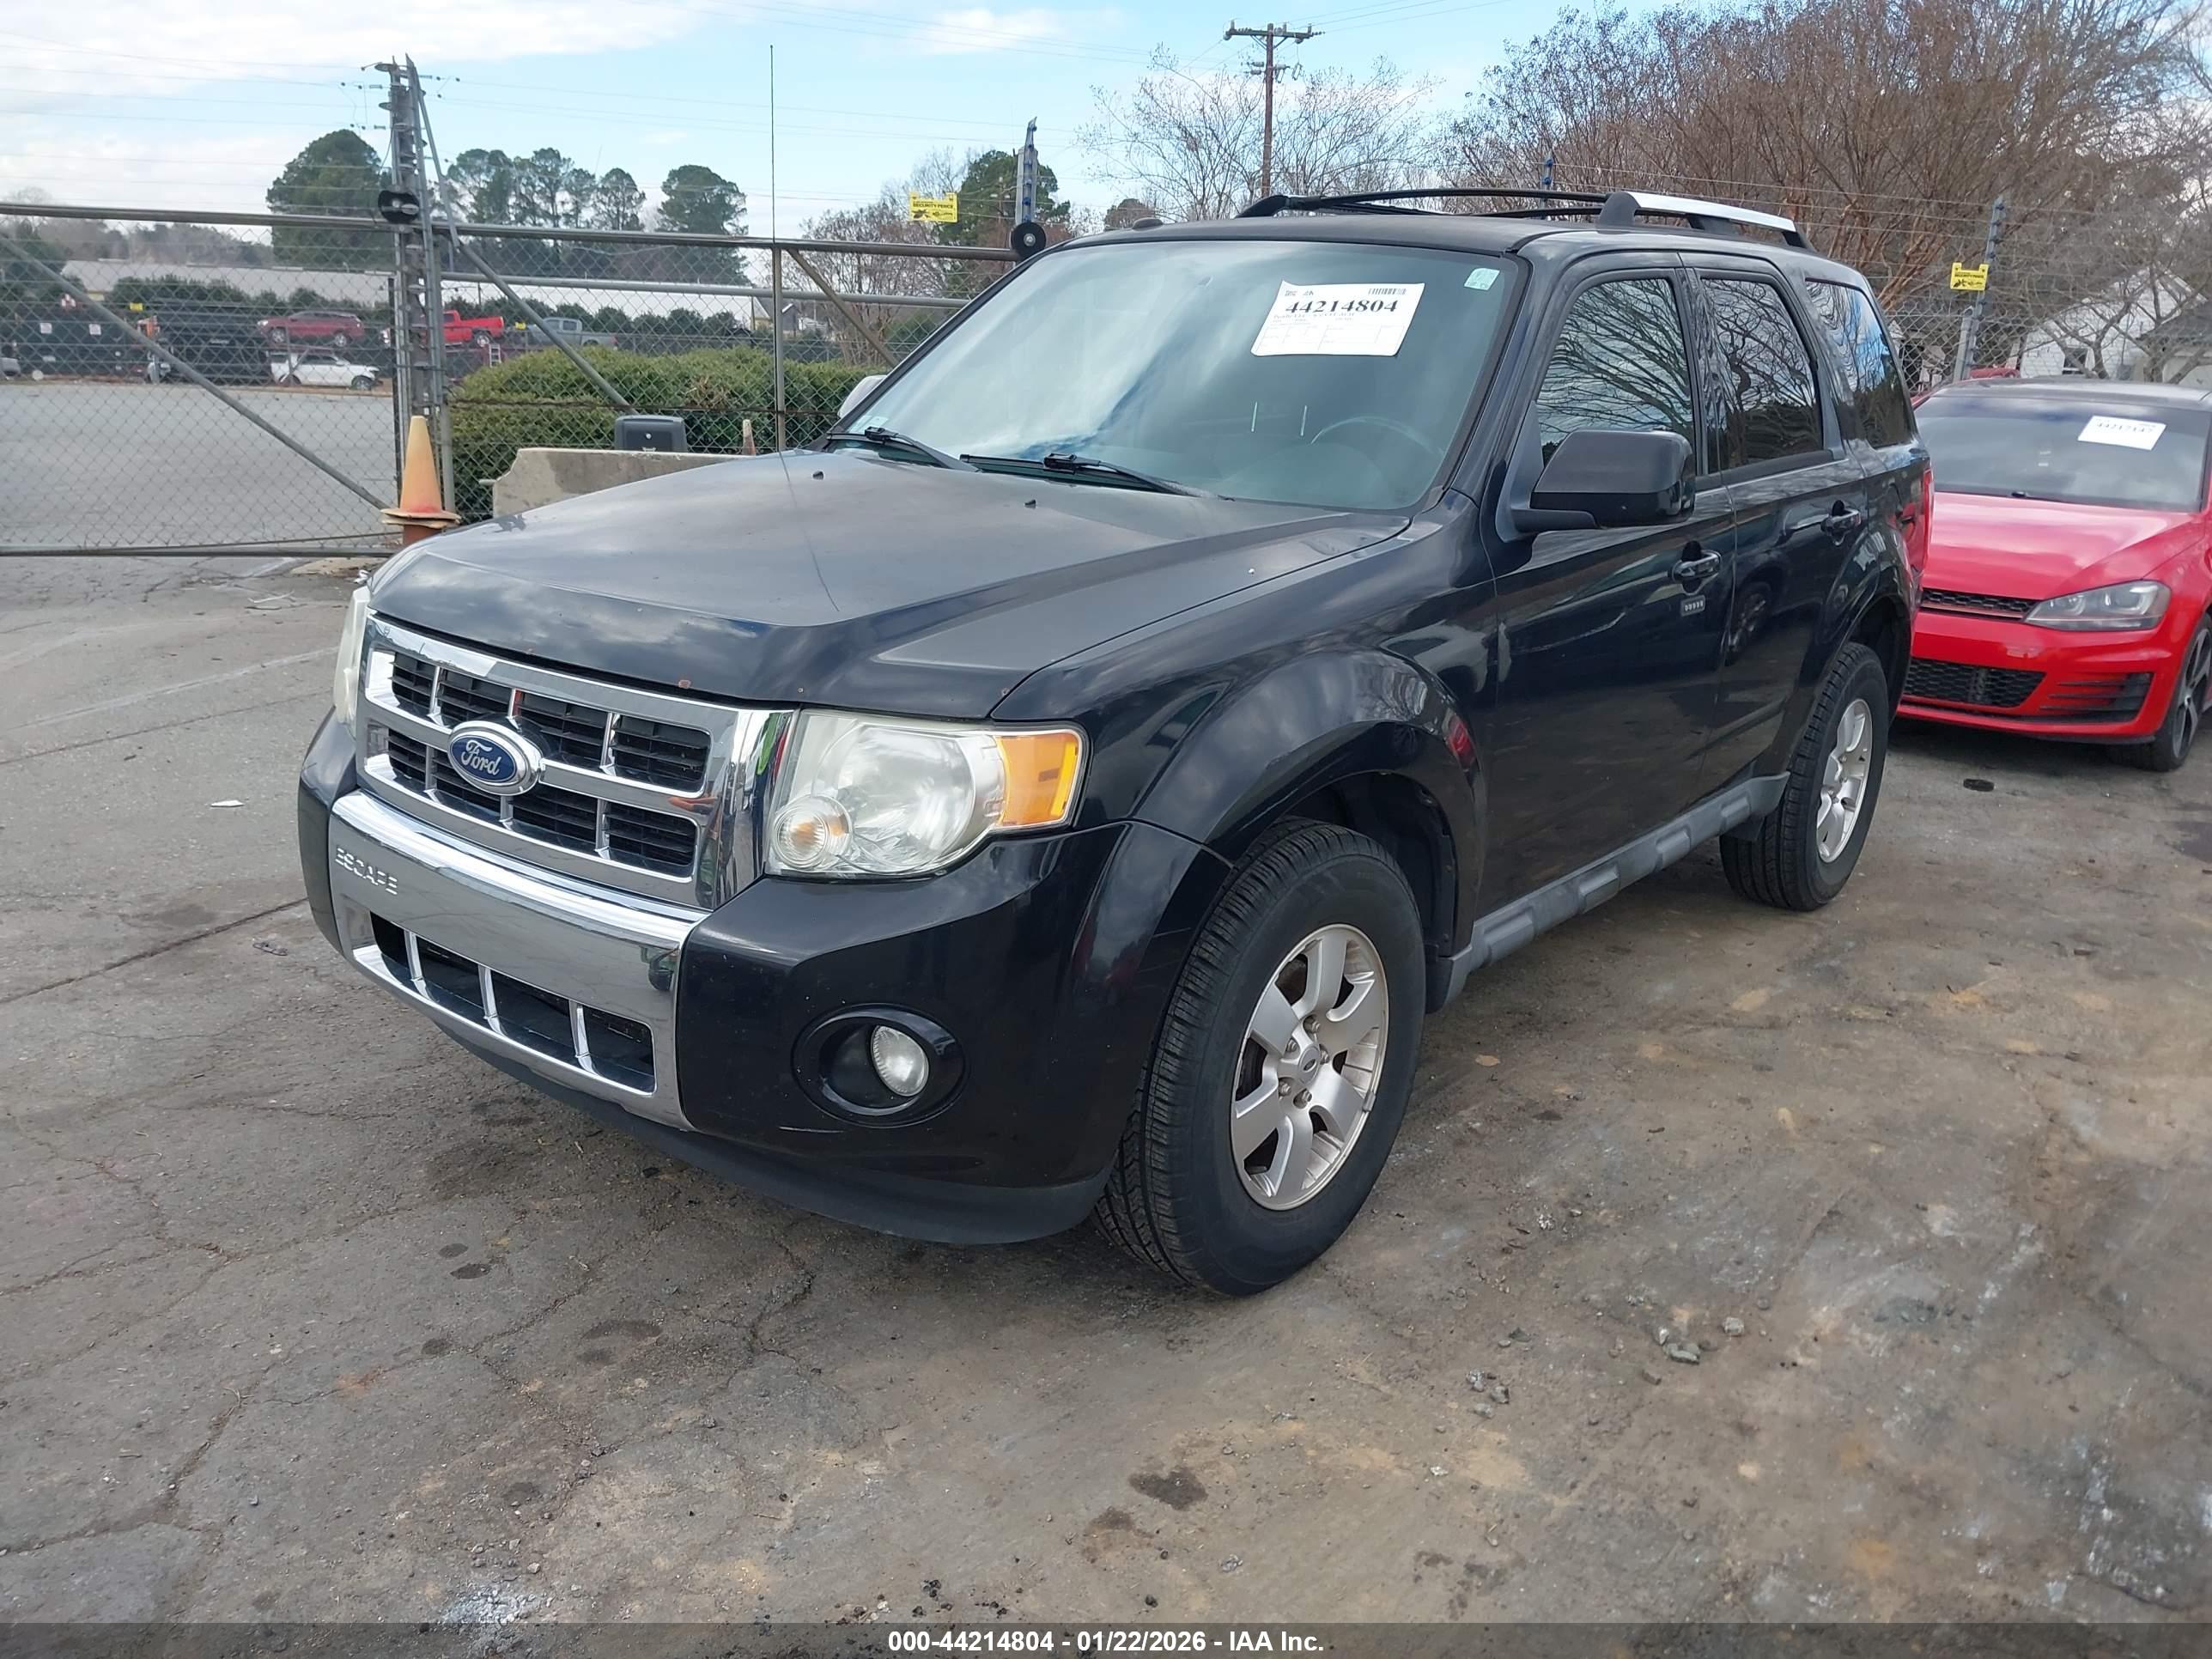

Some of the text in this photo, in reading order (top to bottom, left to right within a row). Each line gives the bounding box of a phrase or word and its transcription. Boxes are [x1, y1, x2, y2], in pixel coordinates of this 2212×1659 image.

[1285, 299, 1399, 313] 44214804
[460, 739, 502, 776] Ford
[335, 847, 398, 895] ESCAPE
